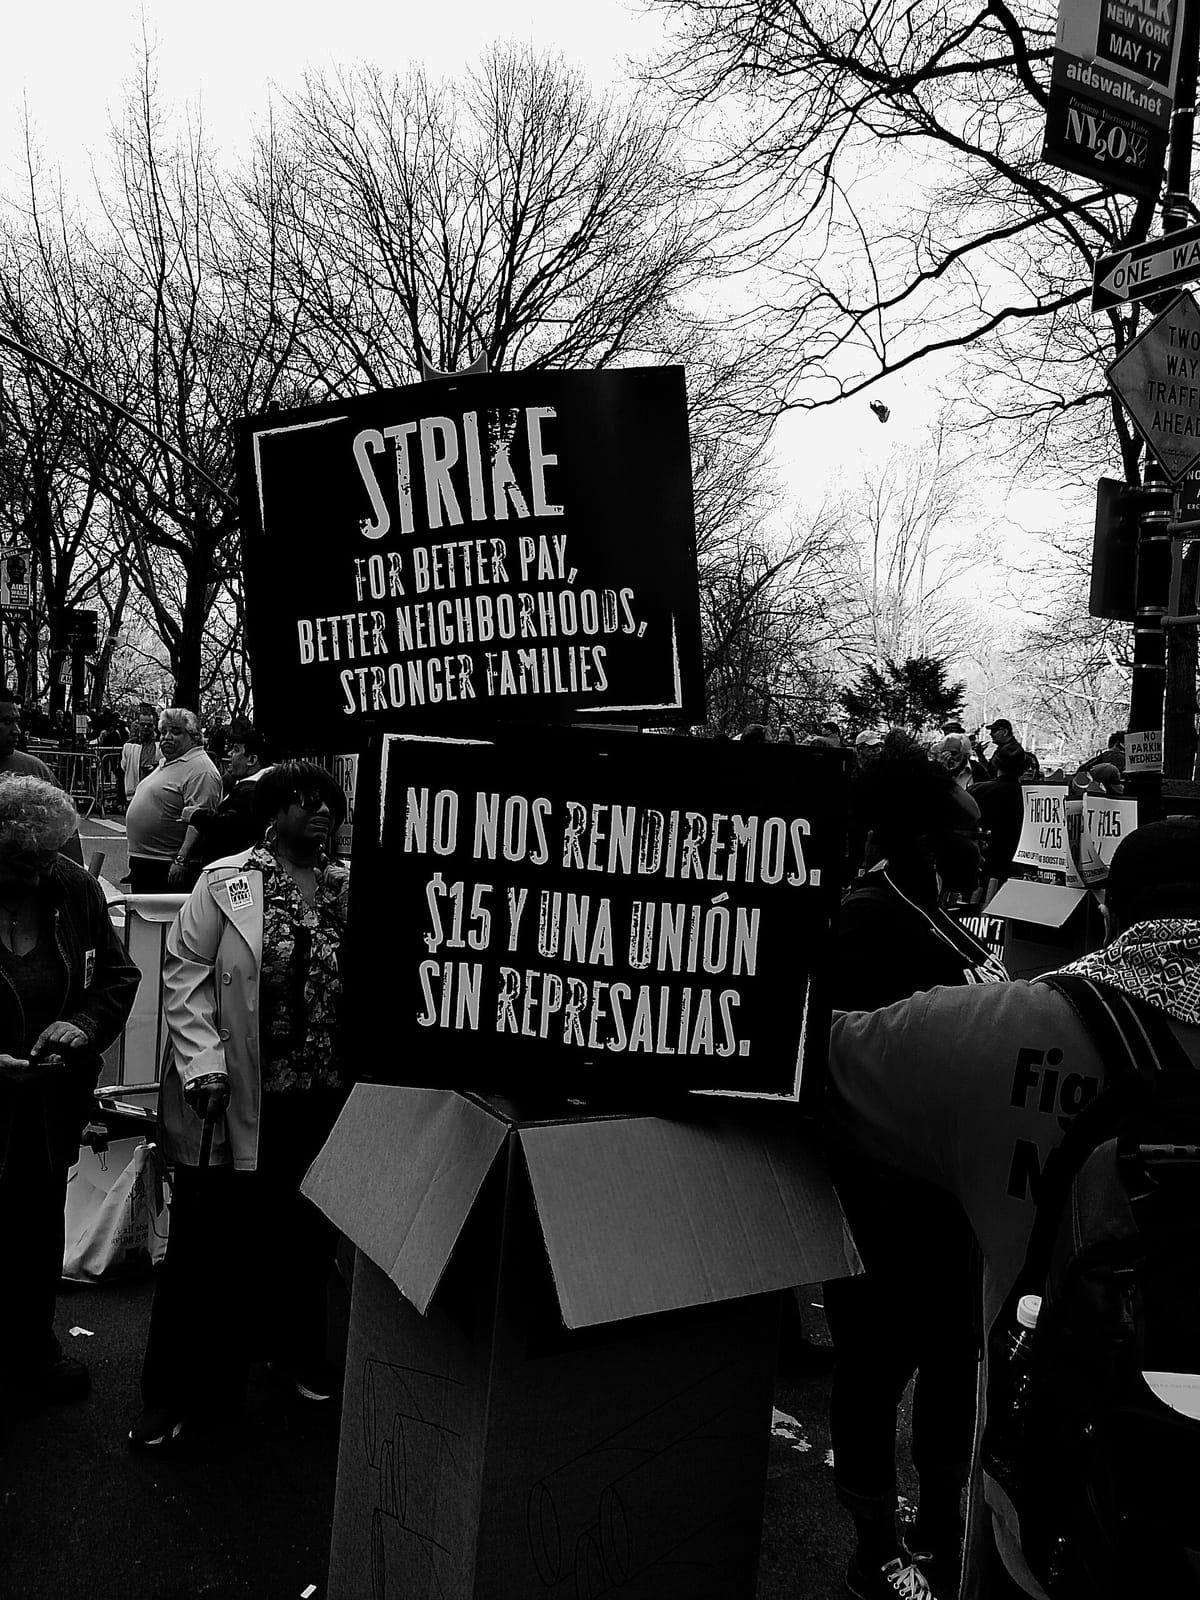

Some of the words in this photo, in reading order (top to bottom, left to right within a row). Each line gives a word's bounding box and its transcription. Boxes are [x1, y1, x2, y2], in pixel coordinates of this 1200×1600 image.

[1107, 2, 1135, 29] NEW
[1138, 17, 1170, 46] YORK
[1119, 0, 1170, 26] ALK
[1110, 33, 1142, 63] MAY
[1146, 50, 1162, 72] 17
[1066, 62, 1162, 116] aidswalk.net
[1114, 258, 1152, 288] ONE
[1168, 326, 1200, 351] TWO
[1167, 354, 1199, 379] WAY
[352, 406, 564, 539] STRIKE
[354, 552, 405, 601] FOR
[413, 538, 510, 594] BETTER
[518, 534, 578, 584] PAY,
[298, 611, 388, 664] BETTER
[396, 587, 648, 652] NEIGHBORHOODS,
[340, 654, 476, 714] STRONGER
[486, 646, 608, 696] FAMILIES
[1144, 732, 1156, 742] NO
[404, 787, 458, 856] NO
[473, 792, 552, 865] NOS
[562, 801, 821, 887] RENDIREMOS.
[423, 872, 494, 954] $15
[506, 886, 528, 952] Y
[538, 890, 614, 966] UNA
[628, 892, 760, 976] UNIÓN
[416, 960, 482, 1031] SIN
[496, 966, 750, 1057] REPRESALIAS.
